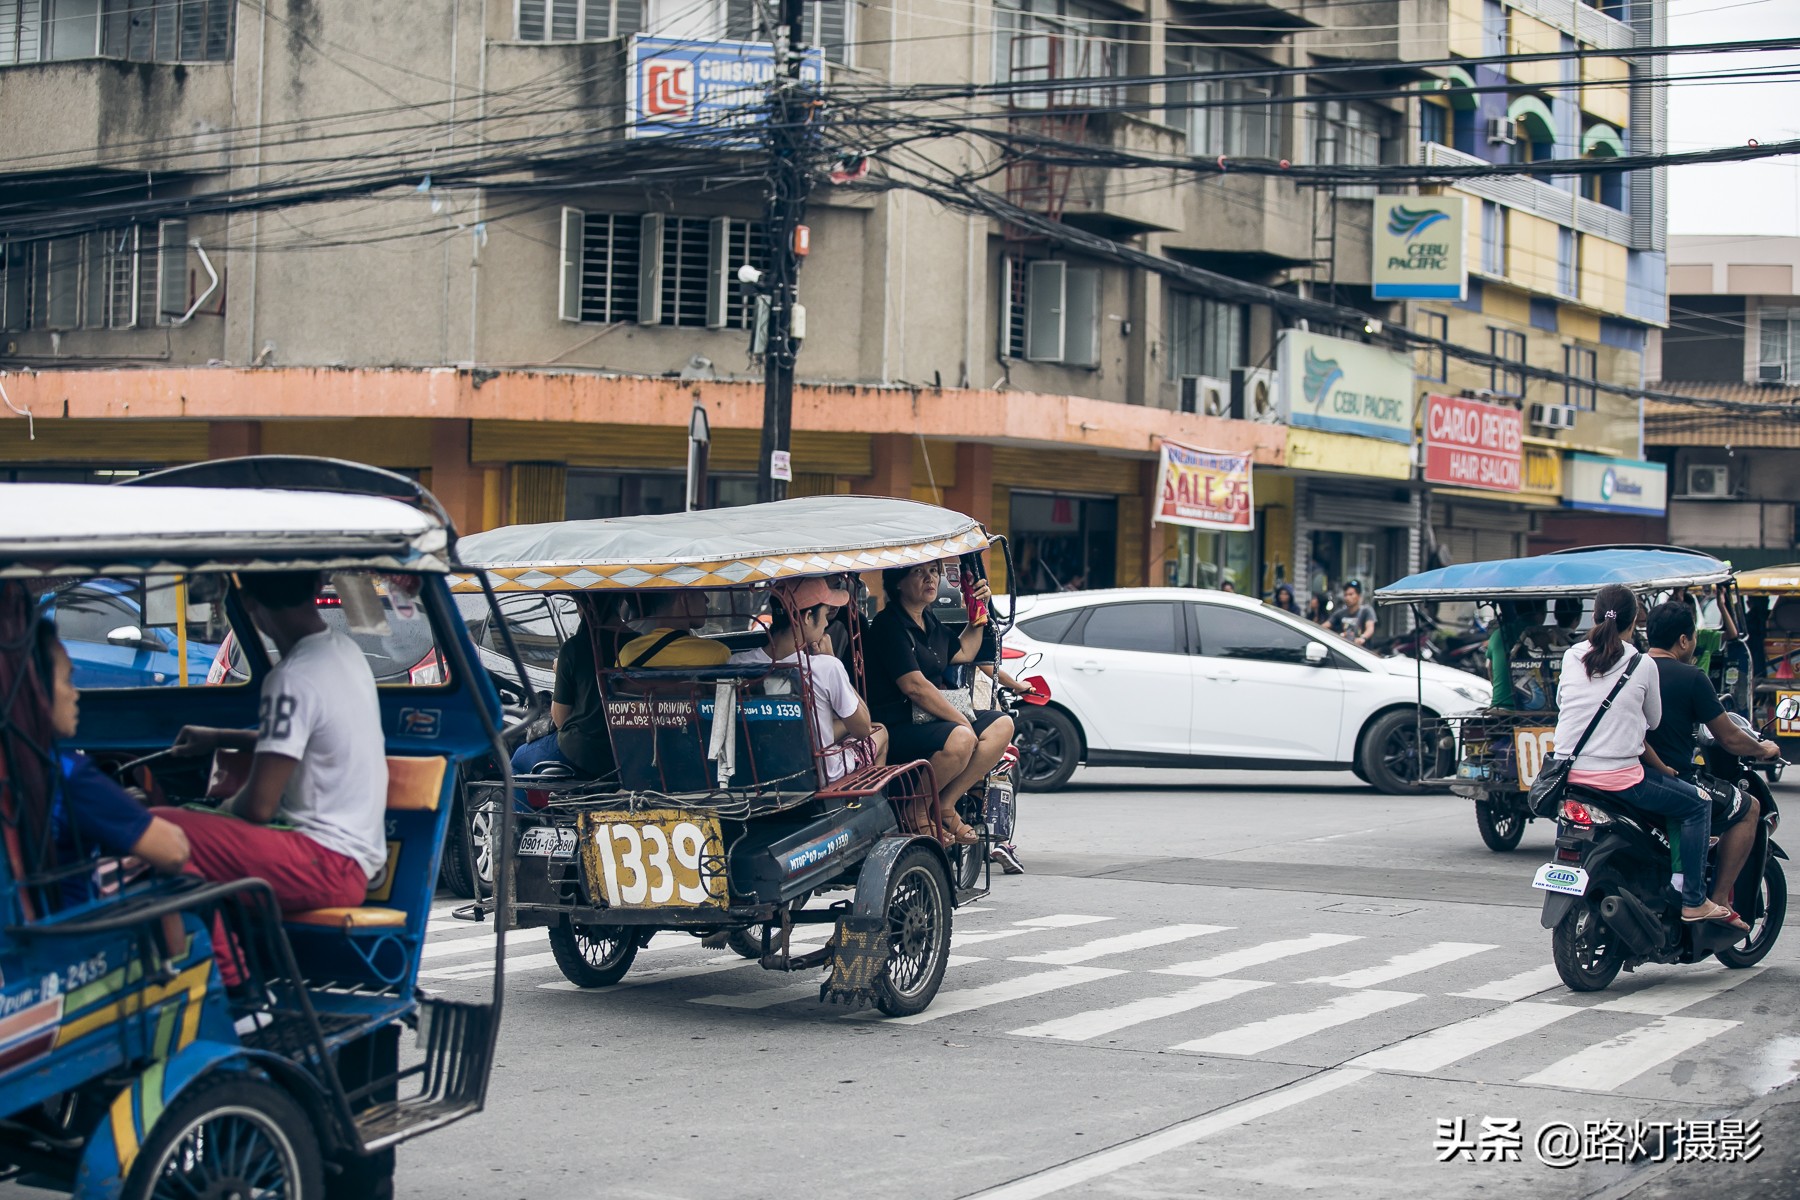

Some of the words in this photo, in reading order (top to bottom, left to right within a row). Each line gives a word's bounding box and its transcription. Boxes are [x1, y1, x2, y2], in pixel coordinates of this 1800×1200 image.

[1407, 243, 1449, 257] CEBU
[1387, 257, 1448, 271] PACIFIC
[1334, 389, 1362, 415] CEBU
[1363, 395, 1404, 423] PACIFIC
[1429, 403, 1480, 445] CARLO
[1481, 412, 1521, 452] REYES
[1449, 451, 1480, 481] HAIR
[1480, 456, 1520, 487] SALON
[1163, 468, 1217, 509] SALE
[608, 702, 636, 714] HOW'S
[639, 702, 654, 714] MY
[658, 702, 692, 714] DRIVING
[761, 704, 773, 716] 19
[776, 704, 801, 718] 1339
[611, 715, 625, 726] Call
[835, 832, 849, 851] 1339
[595, 822, 711, 906] 1339
